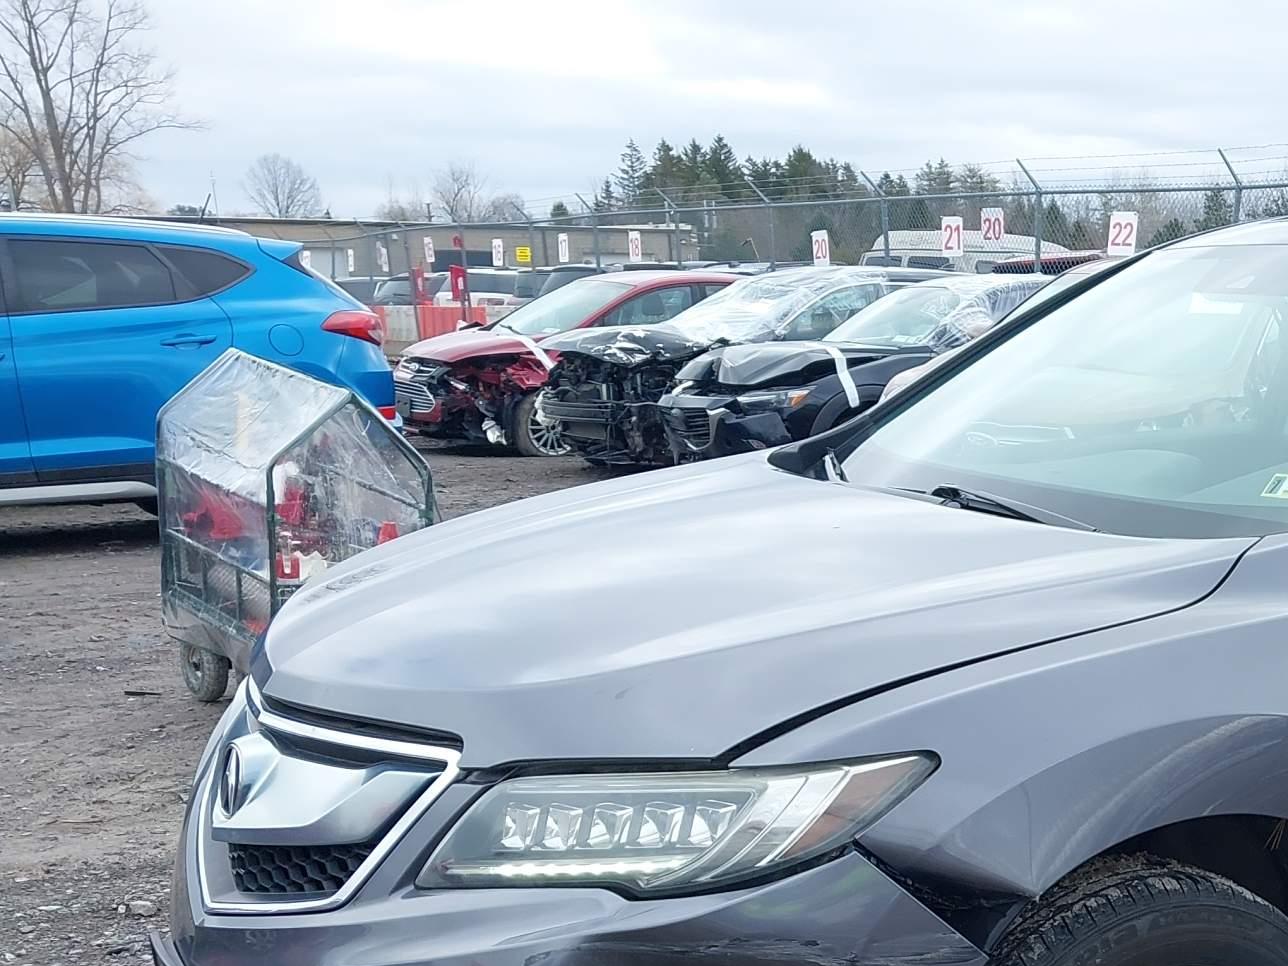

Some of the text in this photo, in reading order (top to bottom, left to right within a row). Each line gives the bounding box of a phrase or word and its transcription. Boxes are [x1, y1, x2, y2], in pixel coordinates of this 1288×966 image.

[944, 223, 962, 251] 21
[983, 217, 1002, 241] 20
[1112, 222, 1136, 247] 22
[629, 237, 640, 257] 18
[814, 238, 827, 260] 20
